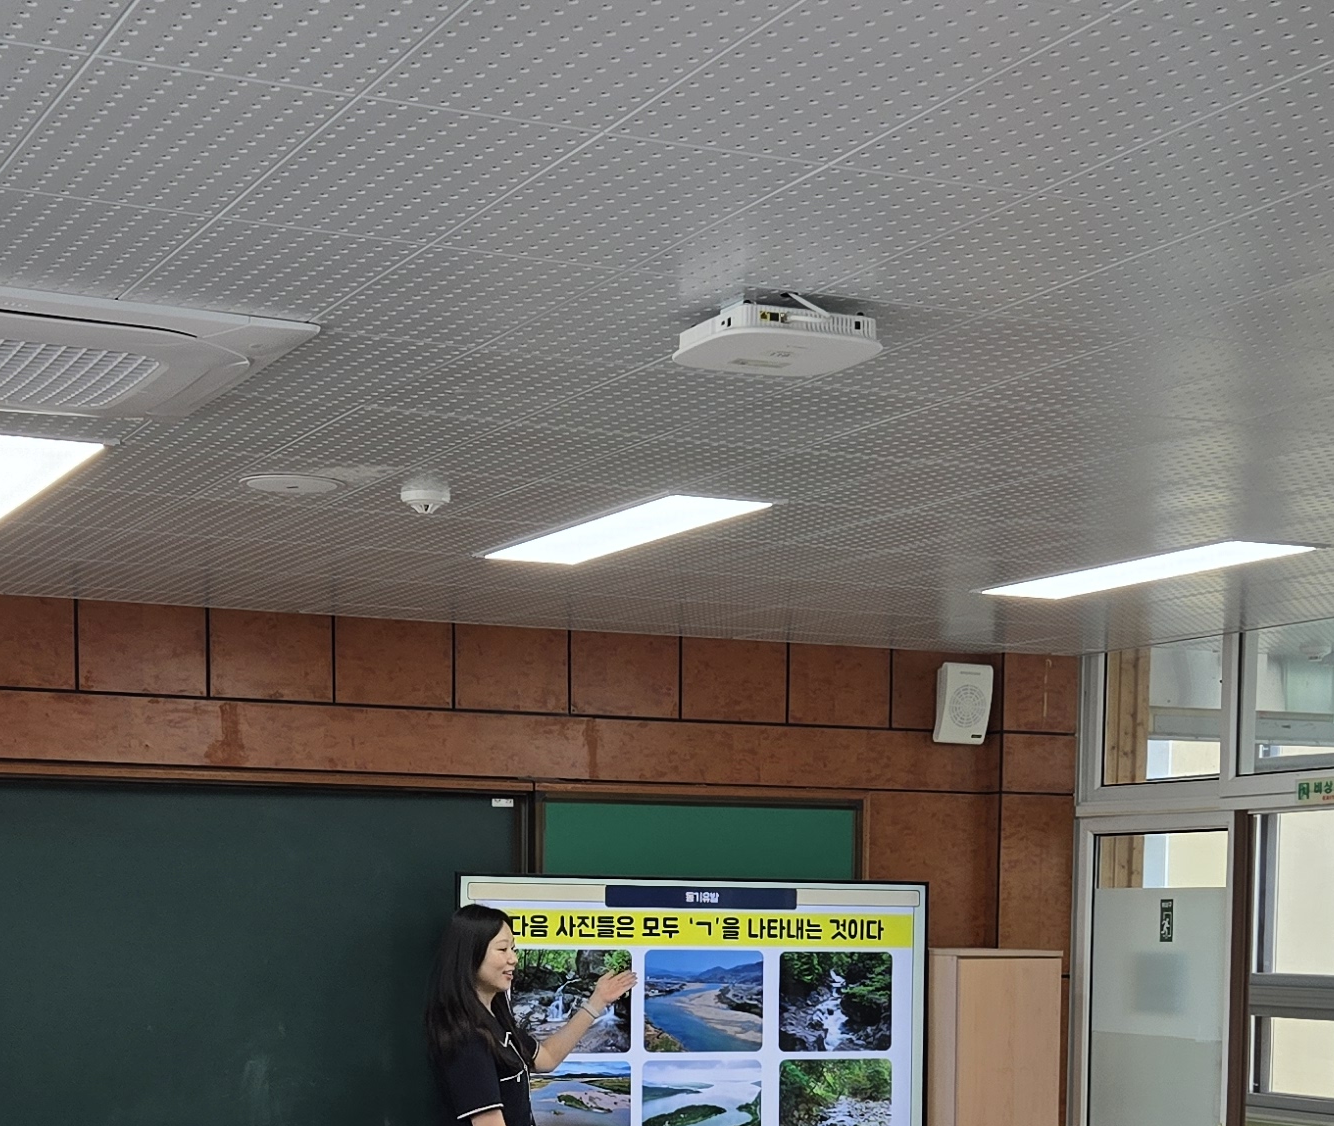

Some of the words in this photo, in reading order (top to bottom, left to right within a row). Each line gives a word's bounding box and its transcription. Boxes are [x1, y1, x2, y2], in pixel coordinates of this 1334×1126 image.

[685, 891, 720, 903] 동기유발
[511, 915, 548, 938] 다음
[556, 915, 634, 938] 사진들은
[642, 917, 679, 939] 모두
[748, 918, 823, 940] 나타내는
[829, 919, 884, 941] 것이다
